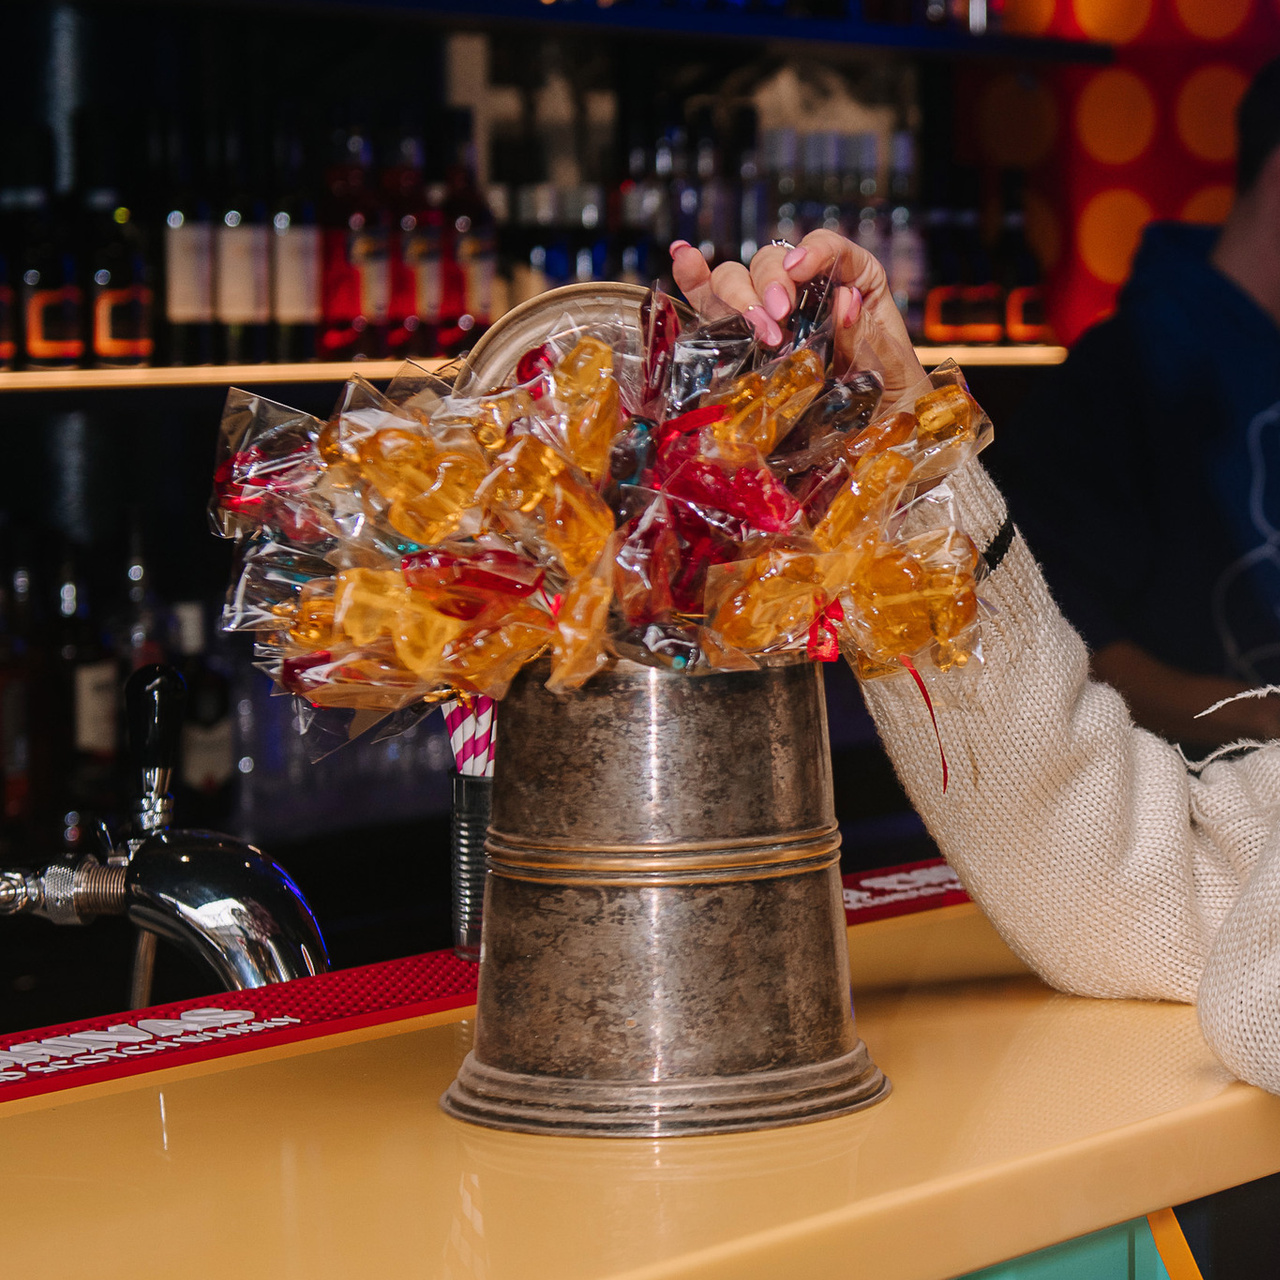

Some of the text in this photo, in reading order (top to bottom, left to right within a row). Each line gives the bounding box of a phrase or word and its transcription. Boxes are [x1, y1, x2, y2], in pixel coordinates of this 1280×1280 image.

[0, 1007, 255, 1069] HIVAS
[27, 1015, 301, 1073] SCOTCH WHISKY
